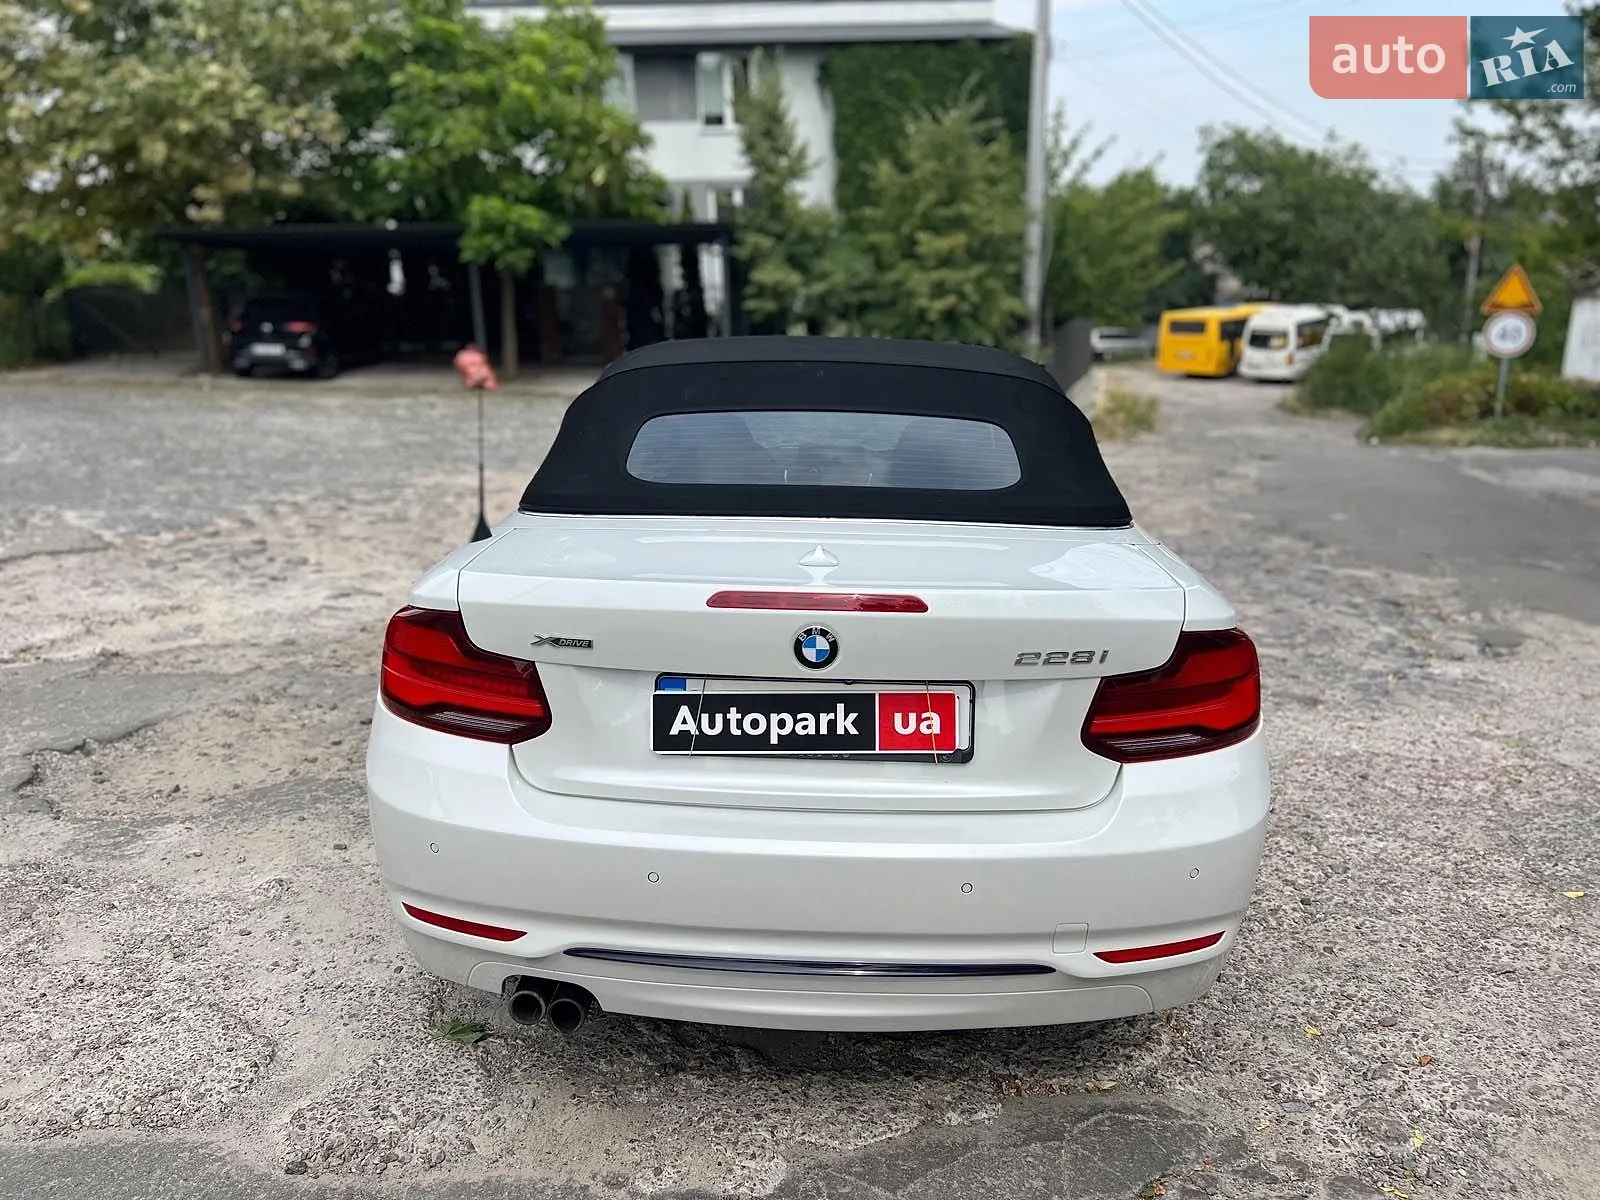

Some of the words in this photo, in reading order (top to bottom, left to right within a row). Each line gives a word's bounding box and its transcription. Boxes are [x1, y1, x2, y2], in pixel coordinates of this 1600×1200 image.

[798, 627, 835, 642] BMW
[669, 703, 859, 744] Autopark
[893, 711, 941, 735] ua
